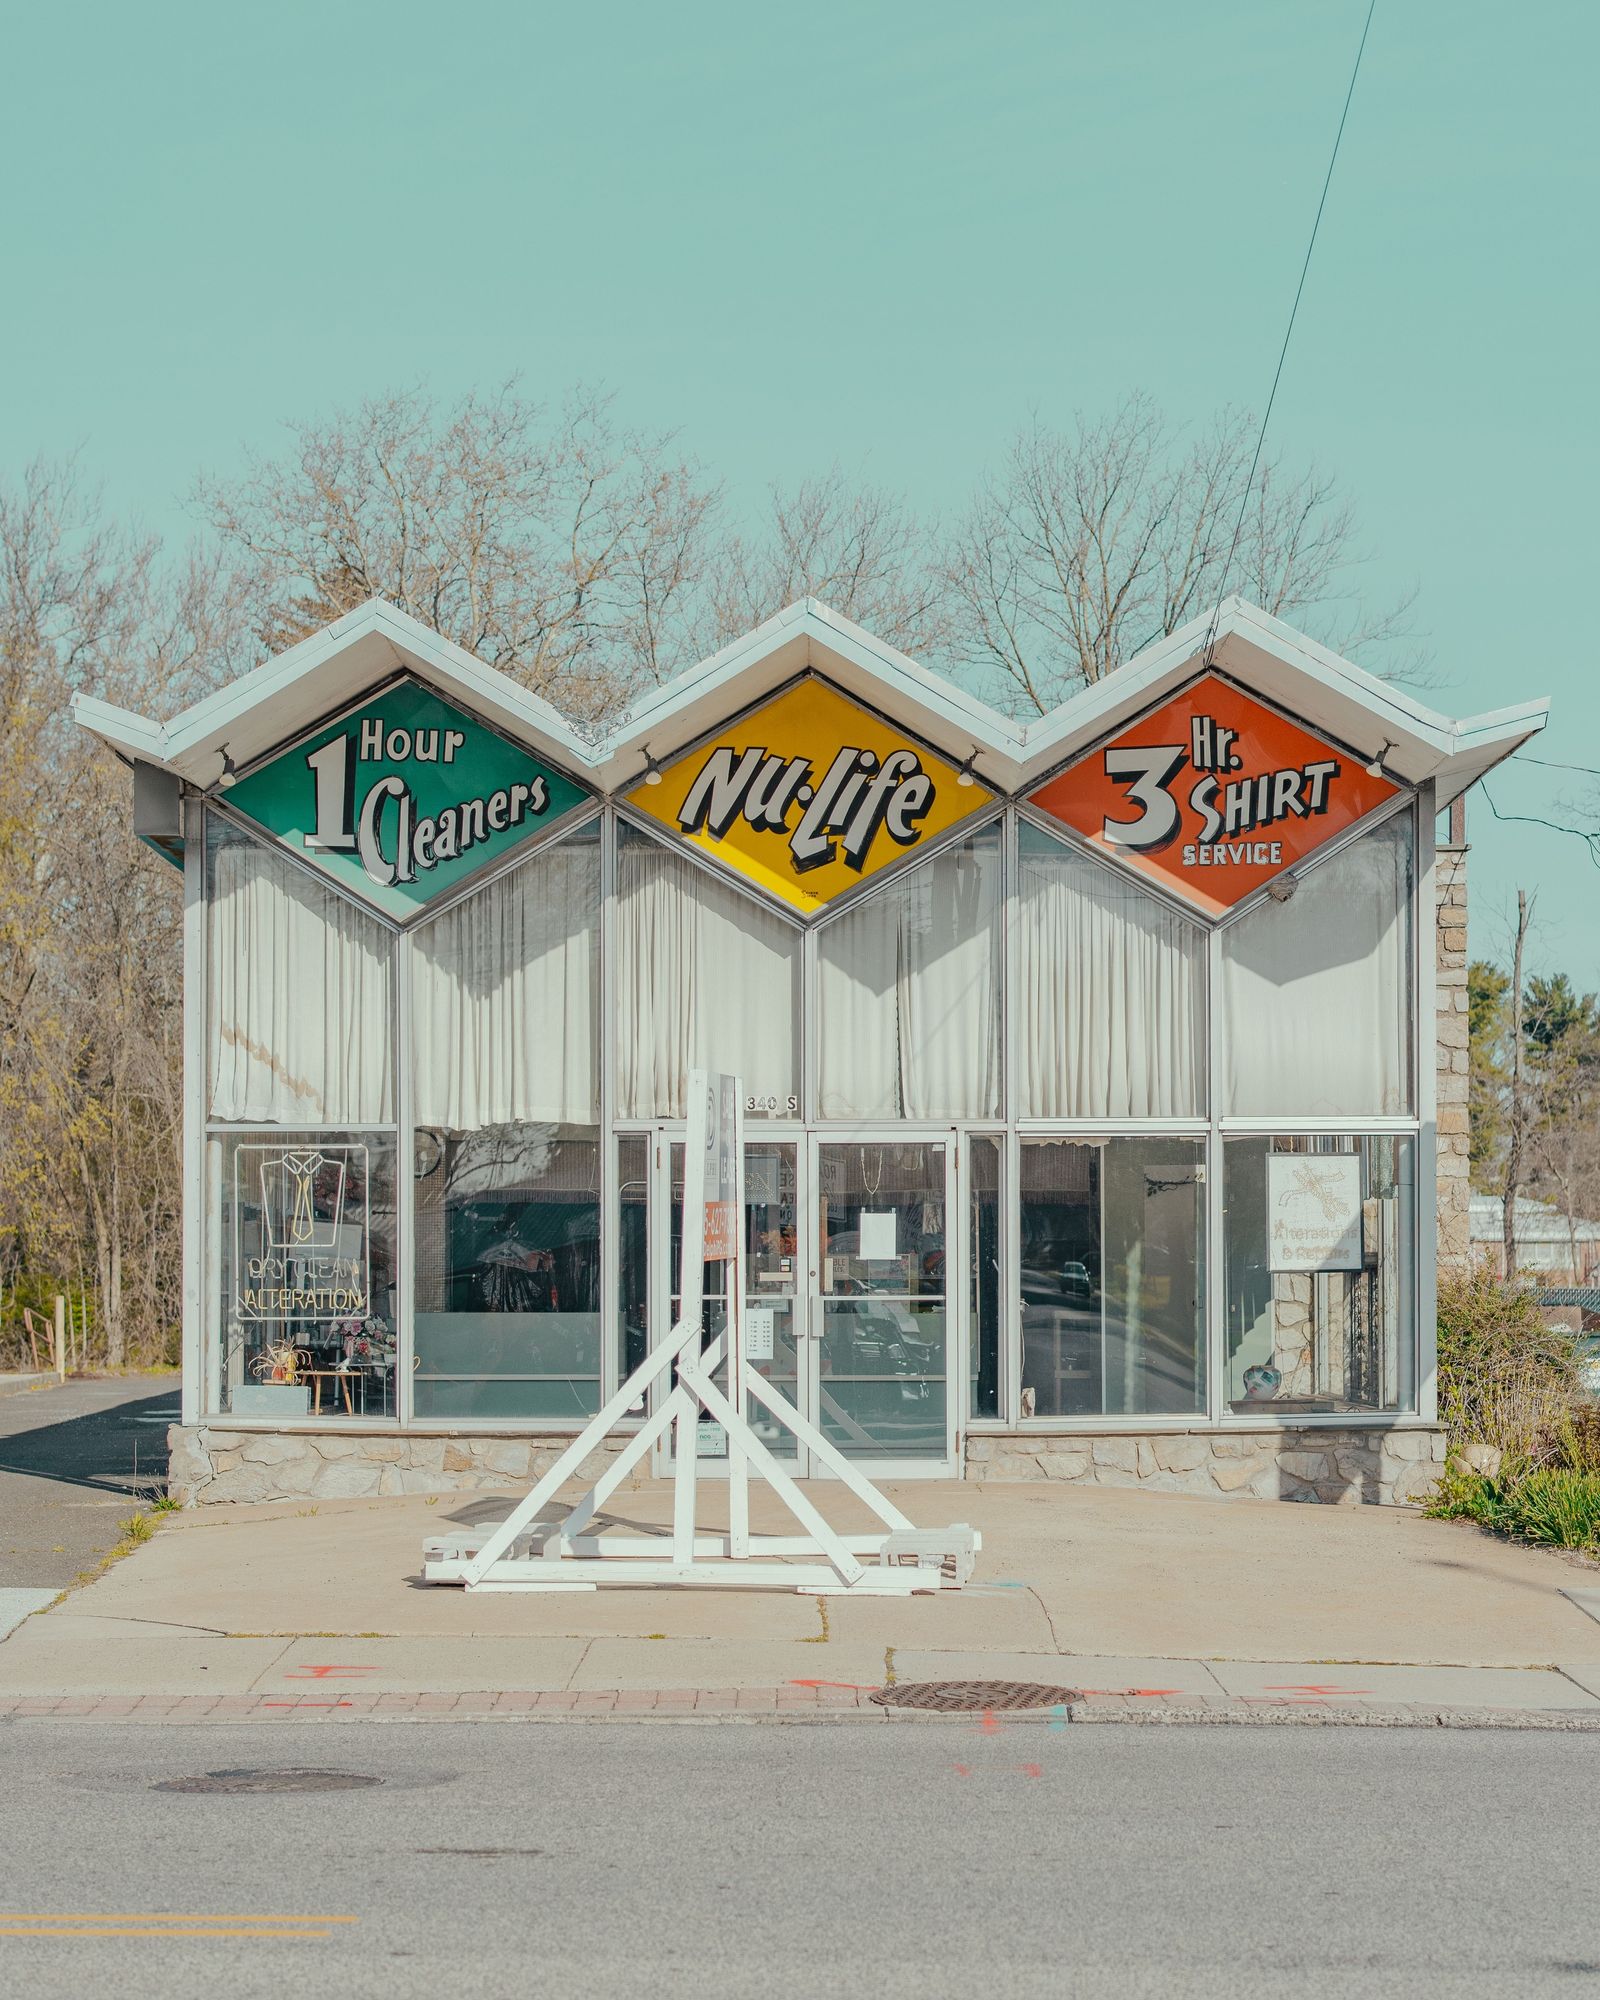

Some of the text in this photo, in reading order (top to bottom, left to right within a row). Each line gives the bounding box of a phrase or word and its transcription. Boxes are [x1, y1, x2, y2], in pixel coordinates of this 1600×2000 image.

[303, 717, 465, 853] 1 Hour
[1102, 715, 1244, 856] 3 Hr.
[1188, 760, 1341, 844] SHIRT
[357, 774, 551, 887] Cleaners
[1182, 841, 1283, 867] SERVICE
[747, 1096, 796, 1110] 340 S
[248, 1257, 285, 1279] DRY
[245, 1288, 363, 1310] ALTERATION
